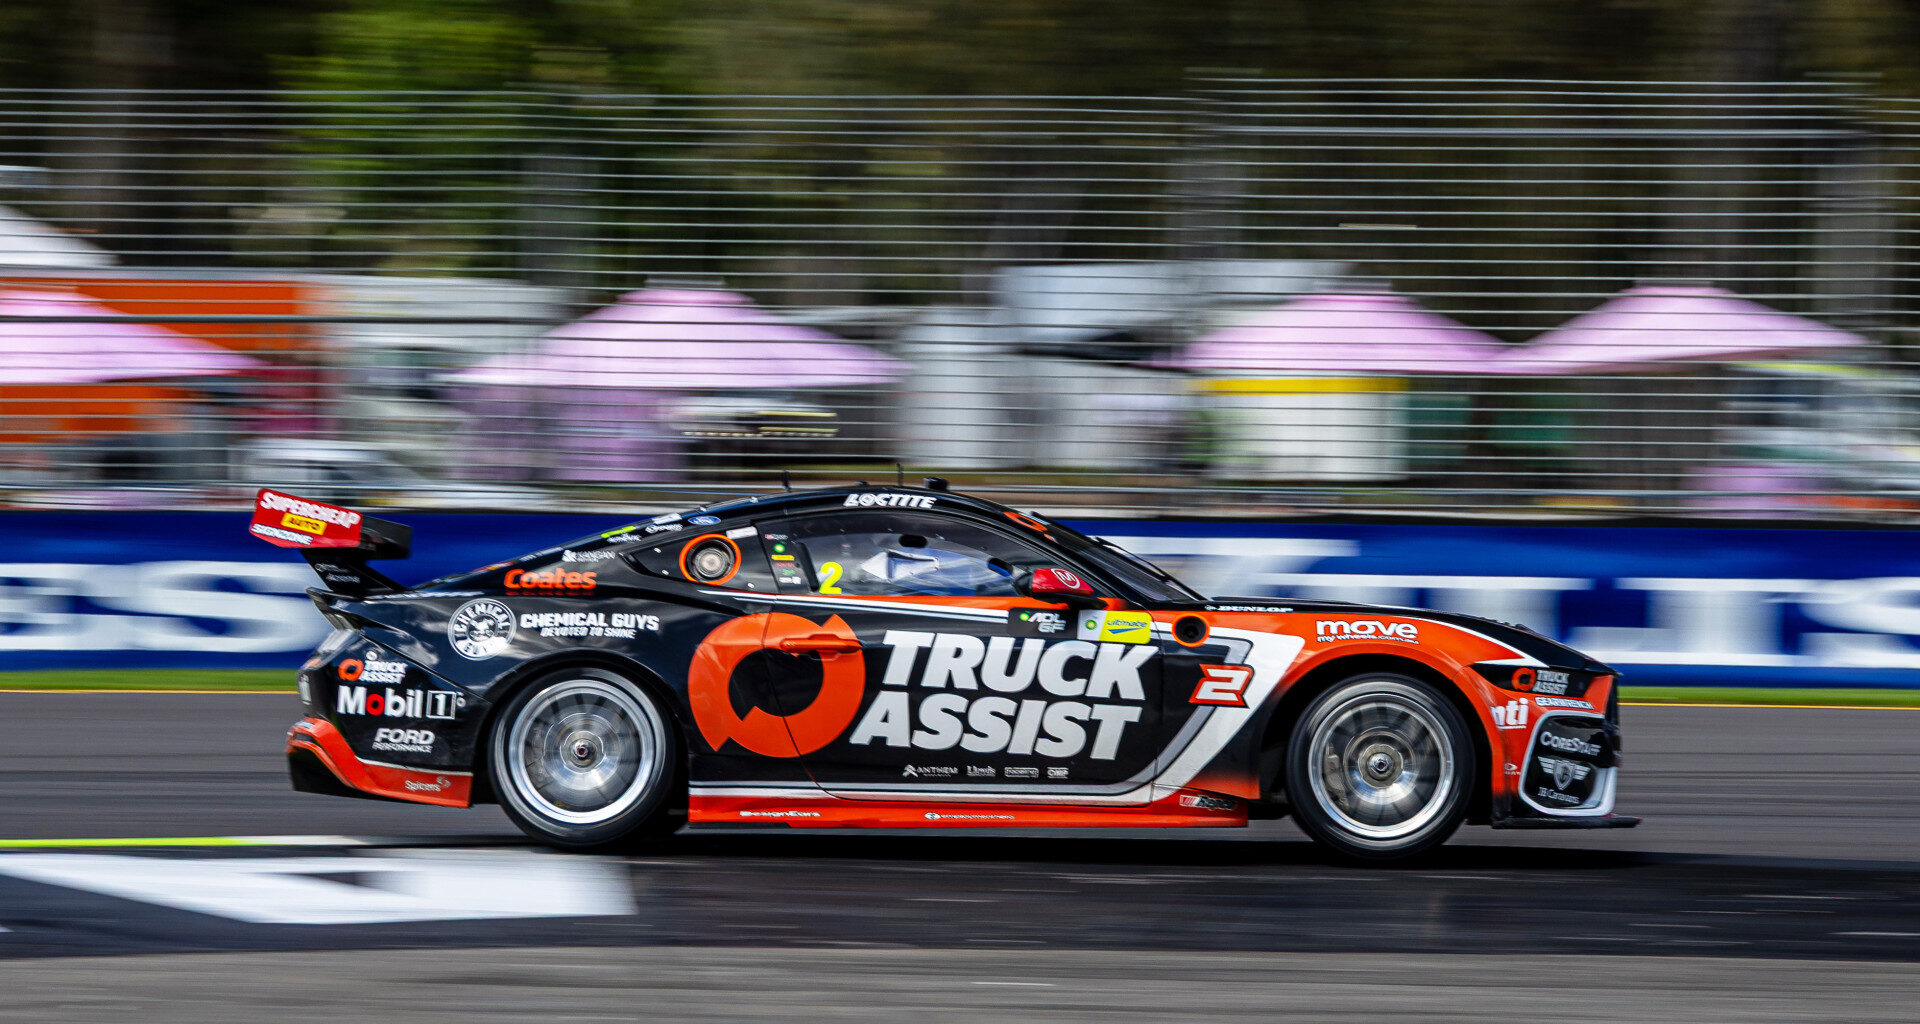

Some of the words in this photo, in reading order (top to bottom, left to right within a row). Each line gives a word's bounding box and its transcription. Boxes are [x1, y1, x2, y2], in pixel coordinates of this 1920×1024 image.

[260, 491, 361, 528] SUPERCHEAP
[843, 493, 937, 509] LOCTITE
[287, 516, 321, 531] AUTO
[251, 523, 314, 546] SIGNZONE
[503, 568, 597, 590] Coates
[819, 561, 844, 595] 2
[1216, 605, 1294, 613] DUNLOP
[520, 613, 608, 628] CHEMICAL
[611, 613, 660, 631] GUYS
[1106, 619, 1148, 628] ultimate
[1316, 620, 1419, 639] move
[540, 626, 588, 637] DEVOTED
[589, 627, 604, 637] TO
[365, 660, 408, 674] TRUCK
[882, 629, 1159, 700] TRUCK
[360, 672, 406, 684] ASSIST
[1193, 668, 1251, 702] 2
[1536, 669, 1570, 684] TRUCK
[1532, 680, 1567, 695] ASSIST
[337, 685, 423, 718] Mobil
[849, 690, 1143, 760] ASSIST
[375, 728, 436, 745] FORD
[405, 780, 441, 792] Spicers
